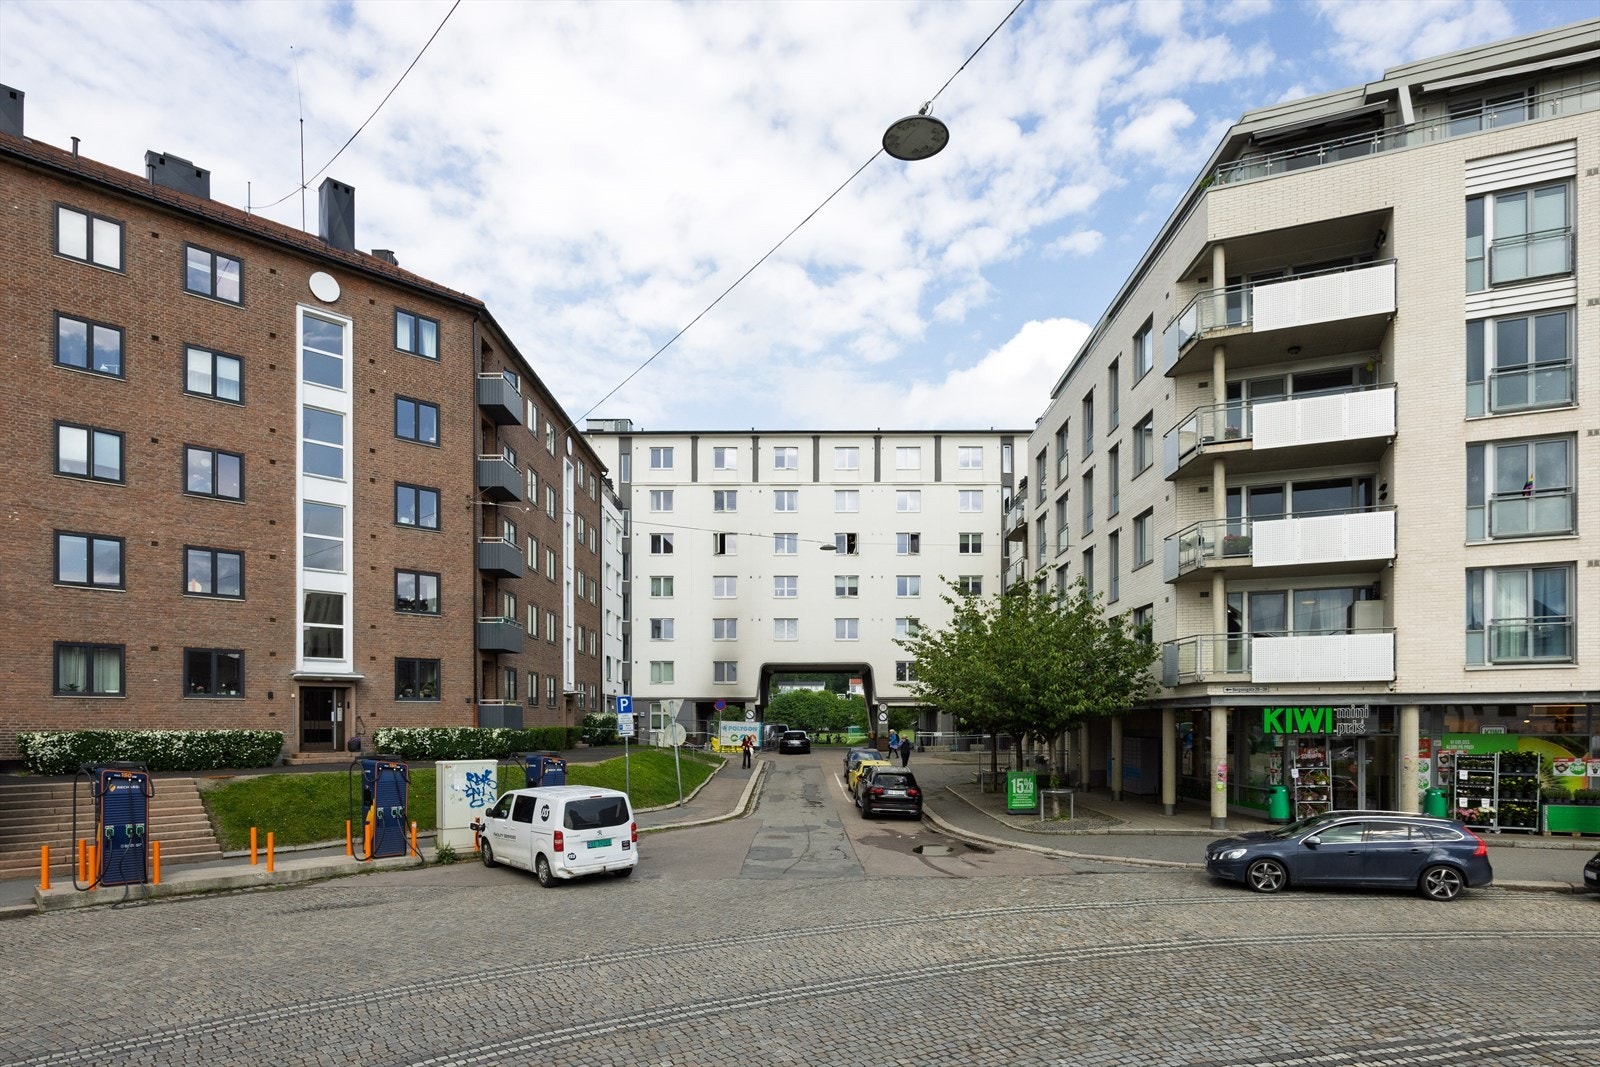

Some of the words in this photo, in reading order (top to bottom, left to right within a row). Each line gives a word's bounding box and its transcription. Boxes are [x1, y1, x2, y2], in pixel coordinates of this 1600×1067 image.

[620, 698, 629, 711] P
[1263, 707, 1333, 734] KIWI
[1336, 704, 1369, 718] mini
[1336, 720, 1366, 736] pris
